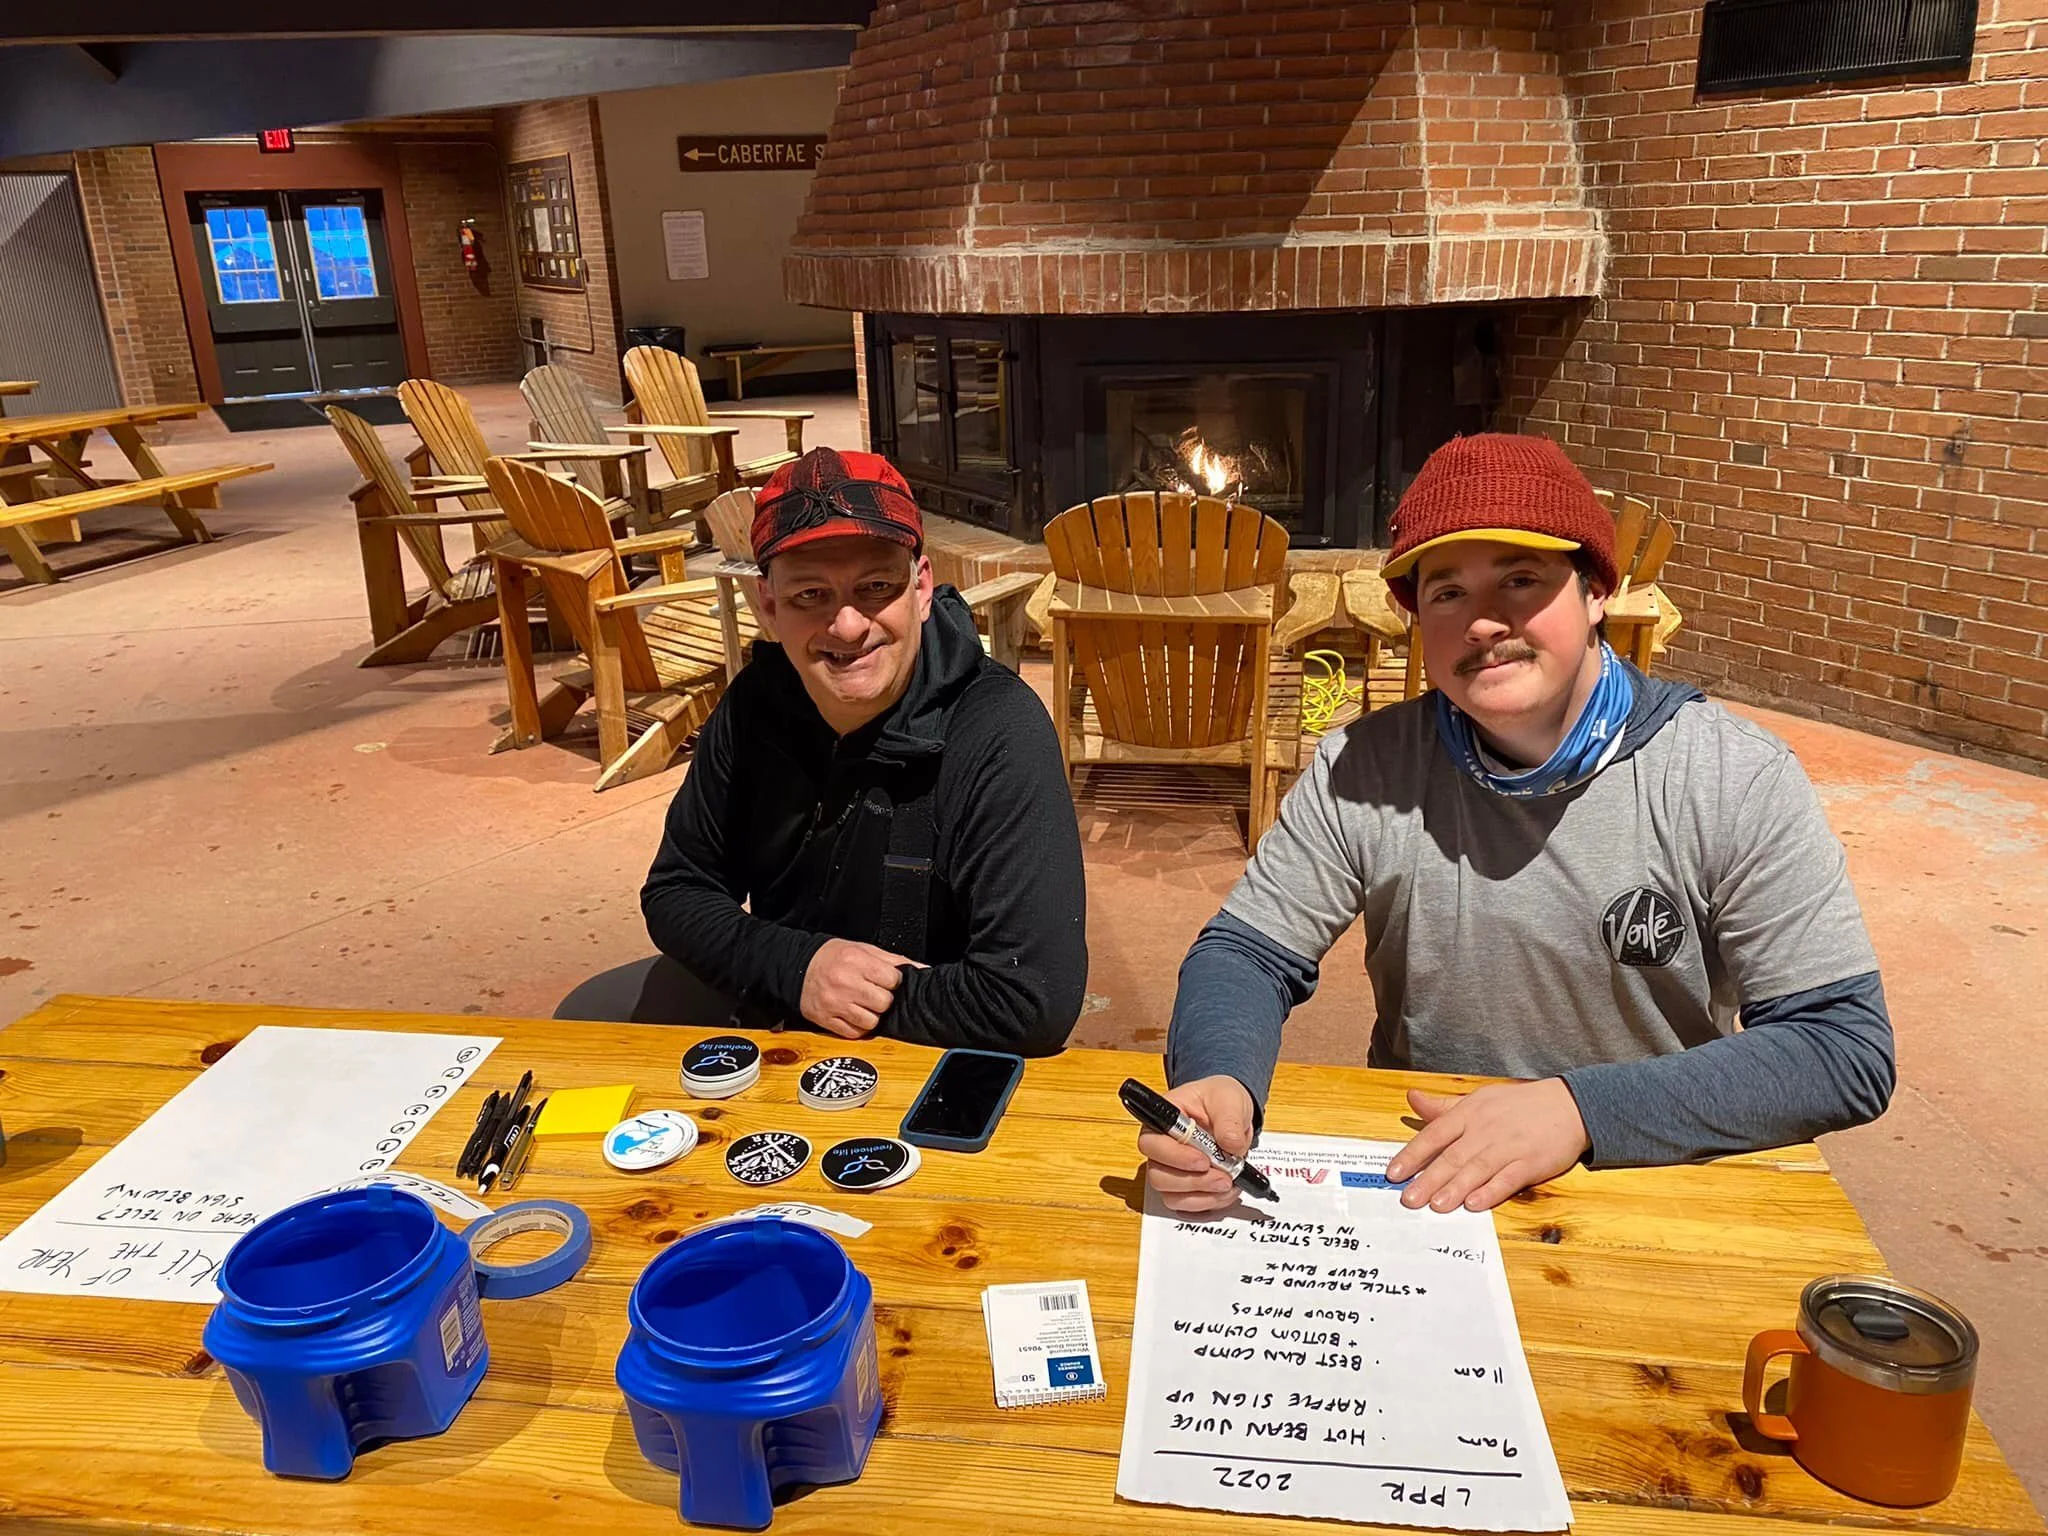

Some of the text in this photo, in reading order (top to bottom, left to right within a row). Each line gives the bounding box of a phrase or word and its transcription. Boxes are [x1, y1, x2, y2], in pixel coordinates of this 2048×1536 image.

[264, 128, 290, 149] EXIT
[717, 143, 825, 164] CABERFAE S
[751, 1134, 799, 1144] SKIER
[1192, 1126, 1225, 1161] Sharpie
[832, 1143, 892, 1156] freeheel life
[728, 1158, 800, 1181] TELEMARK
[1286, 1168, 1310, 1178] Bill
[195, 1194, 243, 1207] SIGN
[95, 1203, 257, 1224] YEAR ON TELE?
[1250, 1217, 1354, 1235] IN SKYVIEW
[1248, 1231, 1310, 1247] STARTS
[1318, 1235, 1359, 1250] BEER
[109, 1240, 162, 1259] THE
[18, 1247, 88, 1278] YEAR
[80, 1267, 131, 1285] OF
[1239, 1273, 1274, 1285] FOR
[1230, 1302, 1359, 1323] GROUP PHOTOS
[1263, 1348, 1306, 1365] RUN
[1315, 1352, 1361, 1370] BEST
[1021, 1374, 1035, 1382] 50
[1165, 1388, 1366, 1415] RAFFLE SIGN UP
[1168, 1412, 1365, 1445] HOT BEAN JUICE
[1212, 1466, 1471, 1507] LPPR 2022
